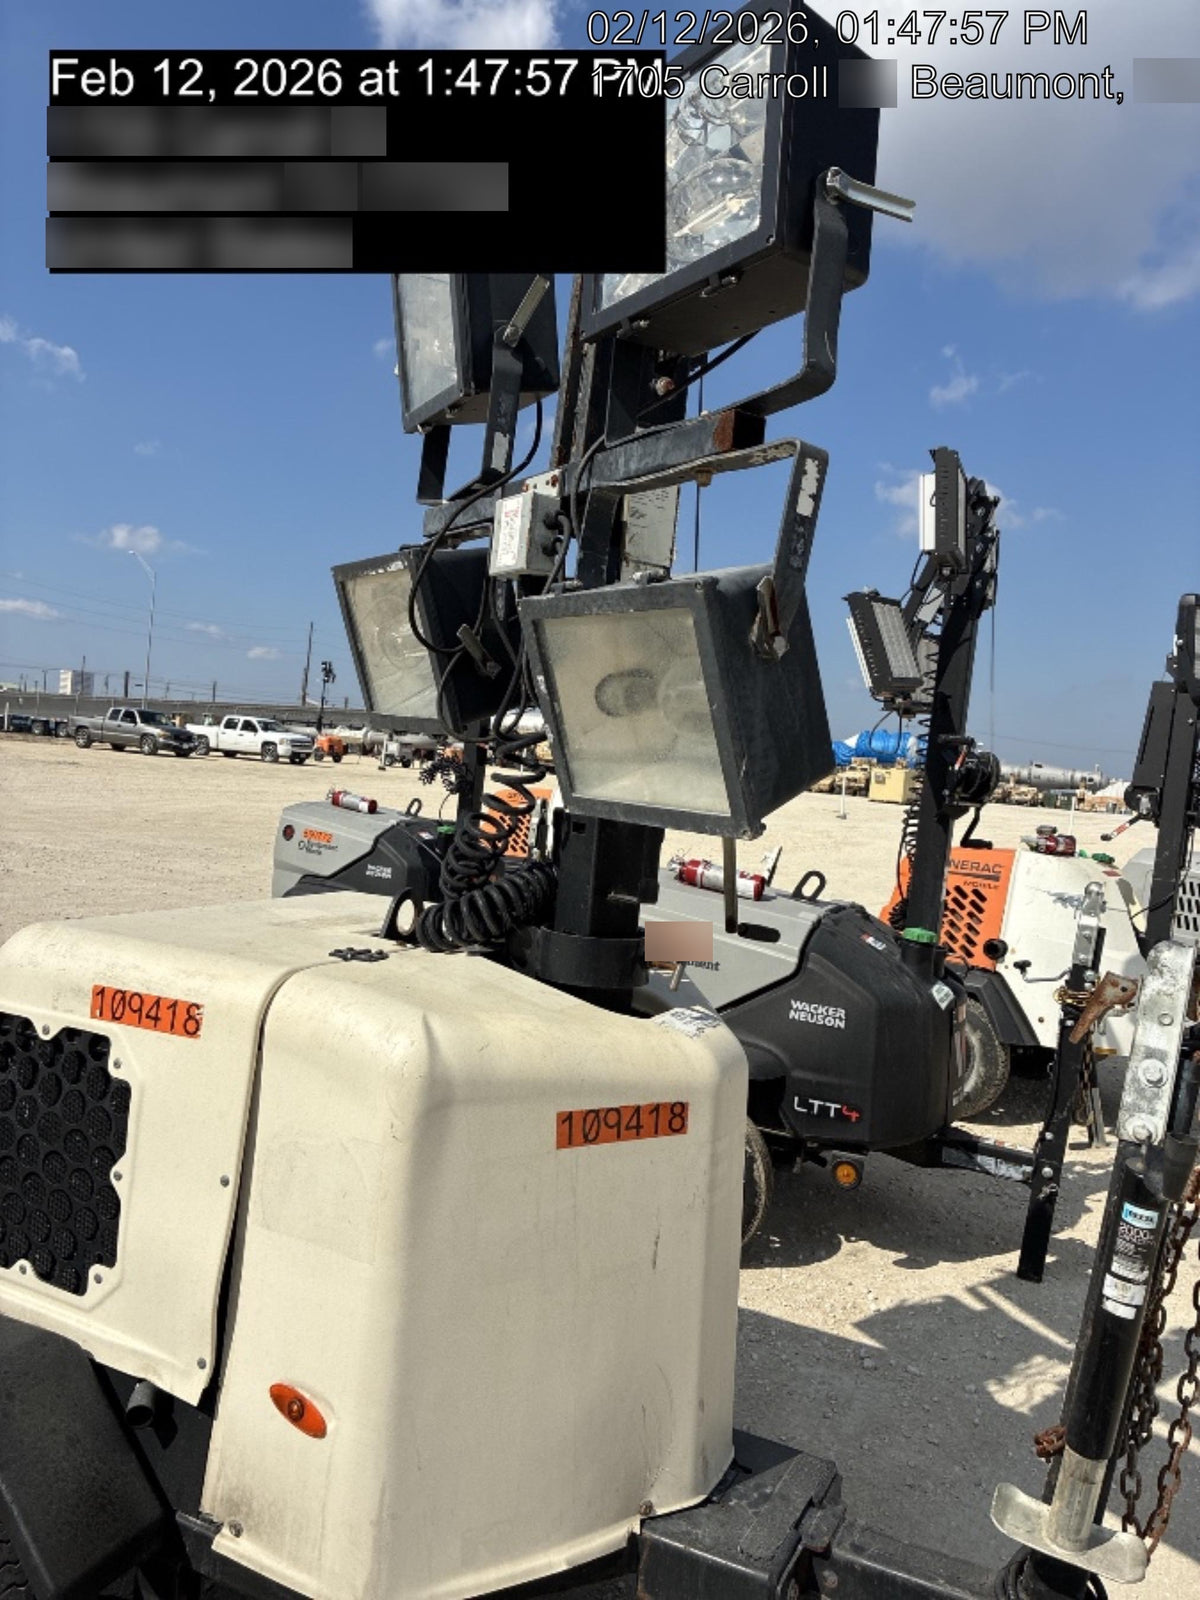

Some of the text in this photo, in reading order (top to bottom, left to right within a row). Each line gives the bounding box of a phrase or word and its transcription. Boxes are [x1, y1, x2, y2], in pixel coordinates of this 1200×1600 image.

[949, 859, 1003, 874] NERAC
[95, 986, 202, 1036] 109418
[789, 1009, 846, 1029] NEUSON
[790, 998, 847, 1019] WACKER
[794, 1096, 860, 1122] LTT4
[561, 1101, 686, 1146] 109418
